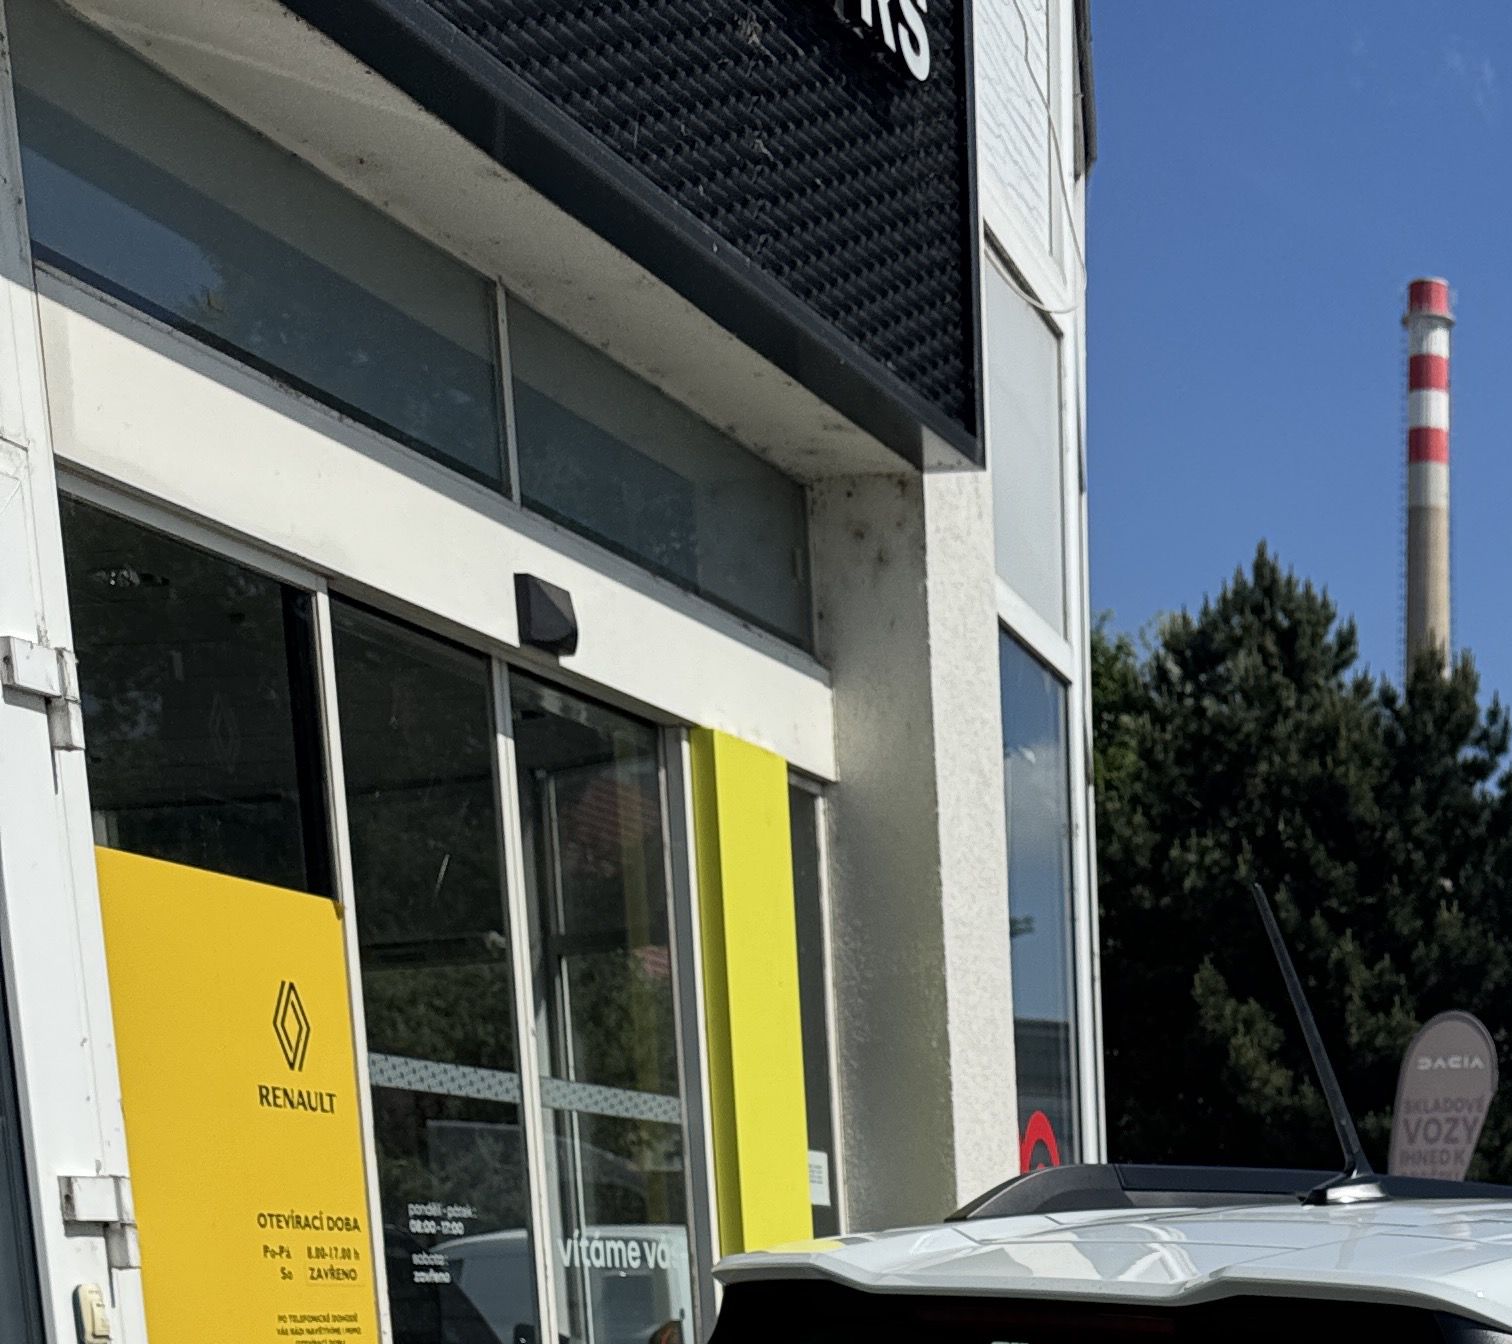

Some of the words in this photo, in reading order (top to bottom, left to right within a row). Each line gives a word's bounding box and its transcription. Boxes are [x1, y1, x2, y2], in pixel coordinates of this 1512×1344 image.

[1416, 1055, 1485, 1070] DACIA
[258, 1084, 337, 1114] RENAULT
[1403, 1116, 1481, 1145] VOZY
[257, 1208, 324, 1231] OTEVÍRACÍ
[326, 1215, 362, 1233] DOBA
[557, 1228, 641, 1269] vítáme
[643, 1233, 681, 1269] vá
[308, 1263, 358, 1281] ZAVŘENO
